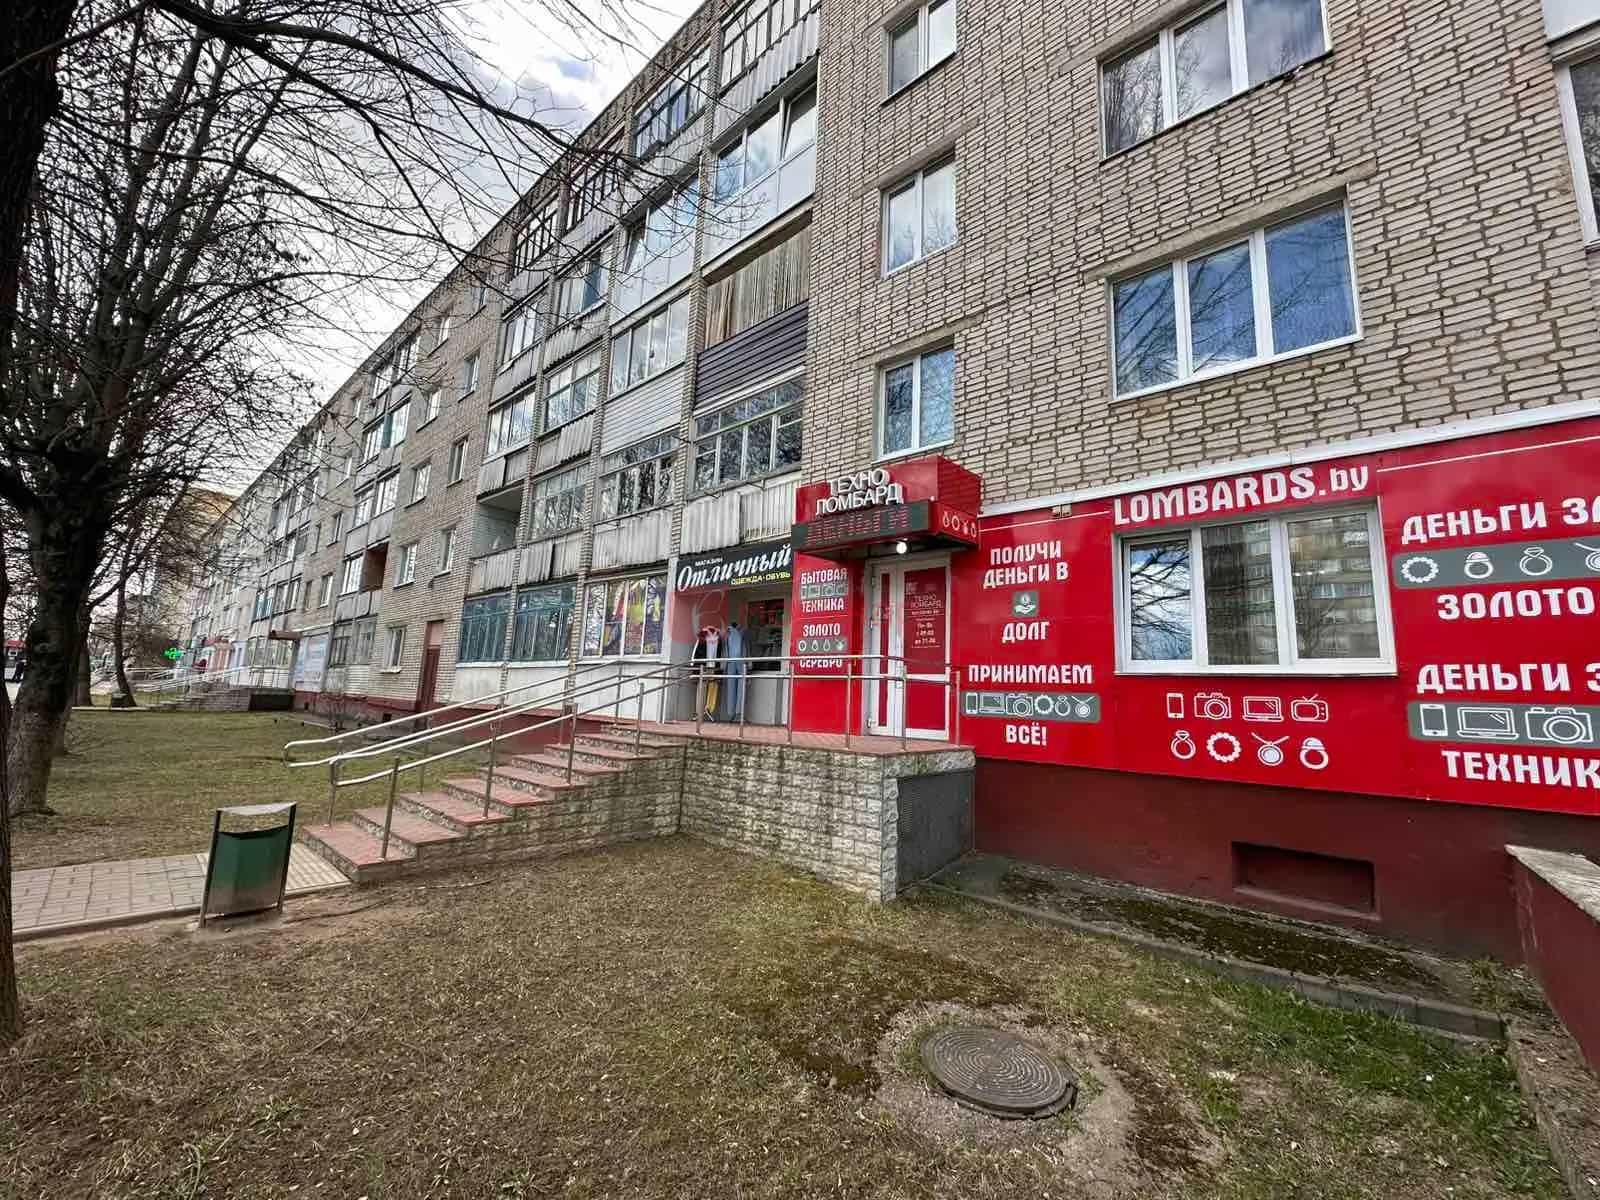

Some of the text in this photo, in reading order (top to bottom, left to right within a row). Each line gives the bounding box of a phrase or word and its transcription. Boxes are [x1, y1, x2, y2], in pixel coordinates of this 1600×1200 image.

[829, 468, 890, 496] ТЕХНО
[1113, 465, 1369, 525] LOMBARDS.by
[815, 482, 904, 516] ЛОМБАРД
[1401, 501, 1548, 545] ДЕНЬГИ
[990, 540, 1062, 566] ПОЛУЧИ
[677, 543, 792, 592] Отличный
[801, 567, 848, 585] БЫТОВАЯ
[983, 561, 1069, 589] ДЕНЬГИ В
[801, 597, 845, 613] ТЕХНИКА
[1437, 586, 1596, 620] ЗОЛОТО
[802, 622, 841, 637] ЗОЛОТО
[1001, 621, 1050, 644] ДОЛГ
[968, 664, 1094, 685] ПРИНИМАЕМ
[1416, 663, 1571, 695] ДЕНЬГИ
[1005, 722, 1048, 746] ВСЁ!
